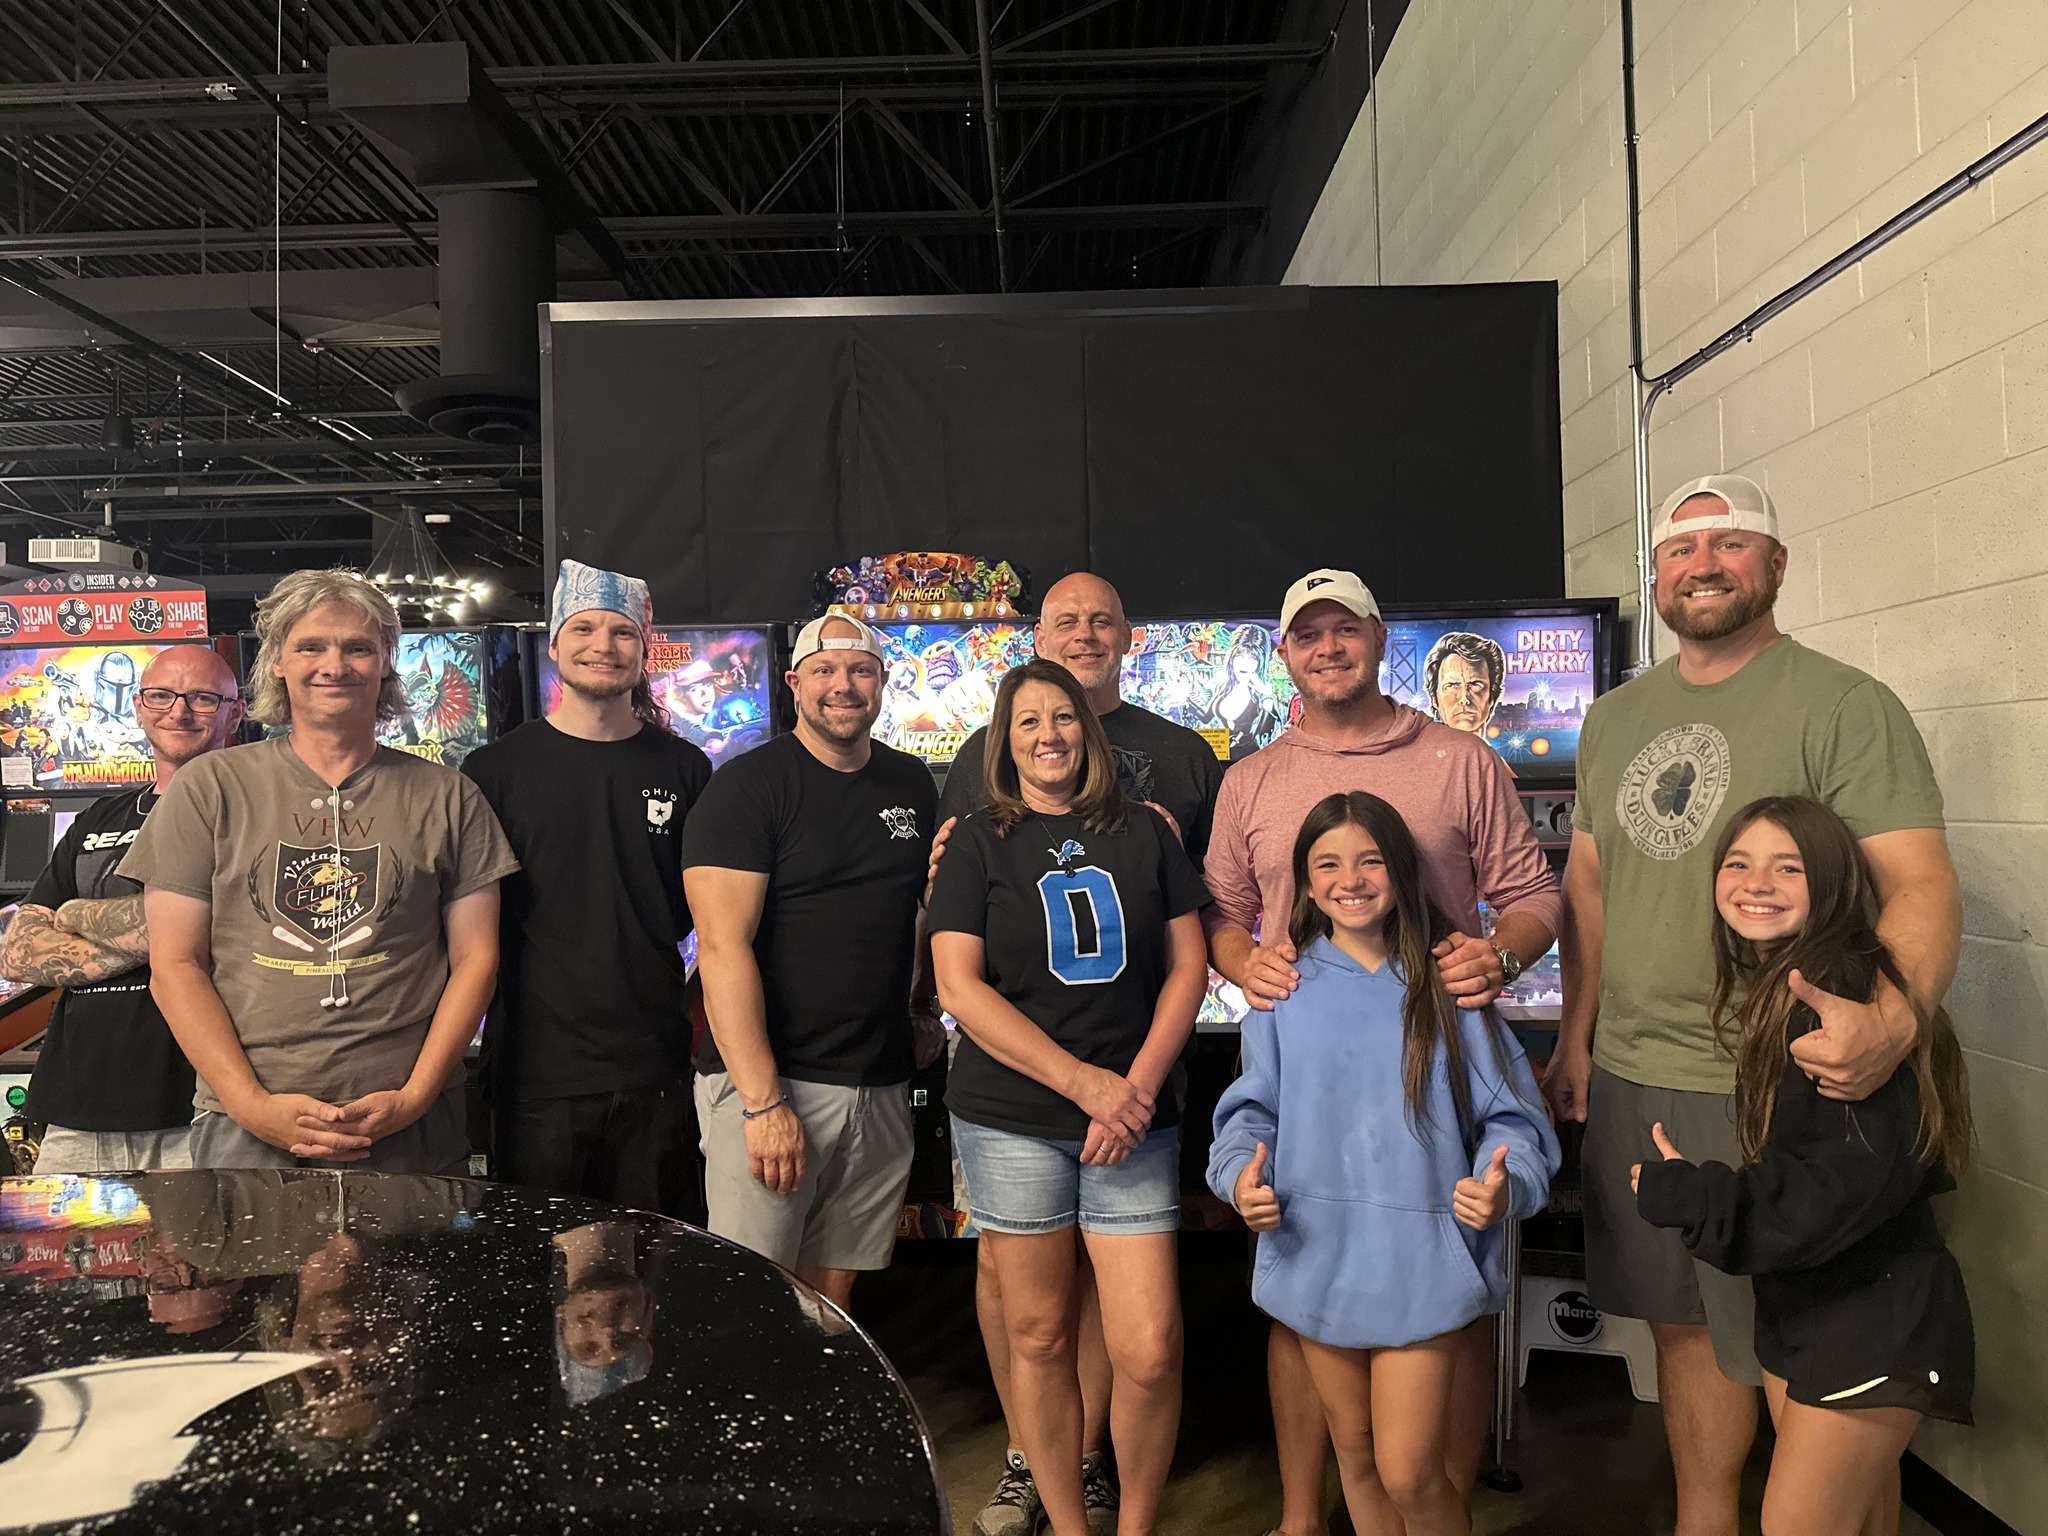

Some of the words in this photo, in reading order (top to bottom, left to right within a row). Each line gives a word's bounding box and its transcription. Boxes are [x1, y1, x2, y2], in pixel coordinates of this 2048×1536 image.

[86, 574, 115, 586] INSIDER
[887, 581, 948, 607] AVENGERS
[22, 606, 53, 626] SCAN
[94, 604, 124, 624] PLAY
[166, 602, 206, 622] SHARE
[651, 633, 668, 642] FLIX
[1517, 629, 1585, 652] DIRTY
[649, 644, 693, 663] NGER
[1506, 650, 1591, 674] HARRY
[646, 660, 681, 673] INGS
[1631, 737, 1685, 788] LUCKY
[1688, 736, 1719, 789] BRAND
[642, 788, 677, 801] OHIO
[292, 812, 377, 838] VFW
[648, 826, 670, 835] USA
[83, 828, 141, 850] REA
[284, 851, 351, 880] Vintage
[296, 876, 359, 907] FLIPPER
[310, 901, 365, 930] World
[271, 960, 292, 968] ARBOR
[1547, 1190, 1584, 1213] DIR
